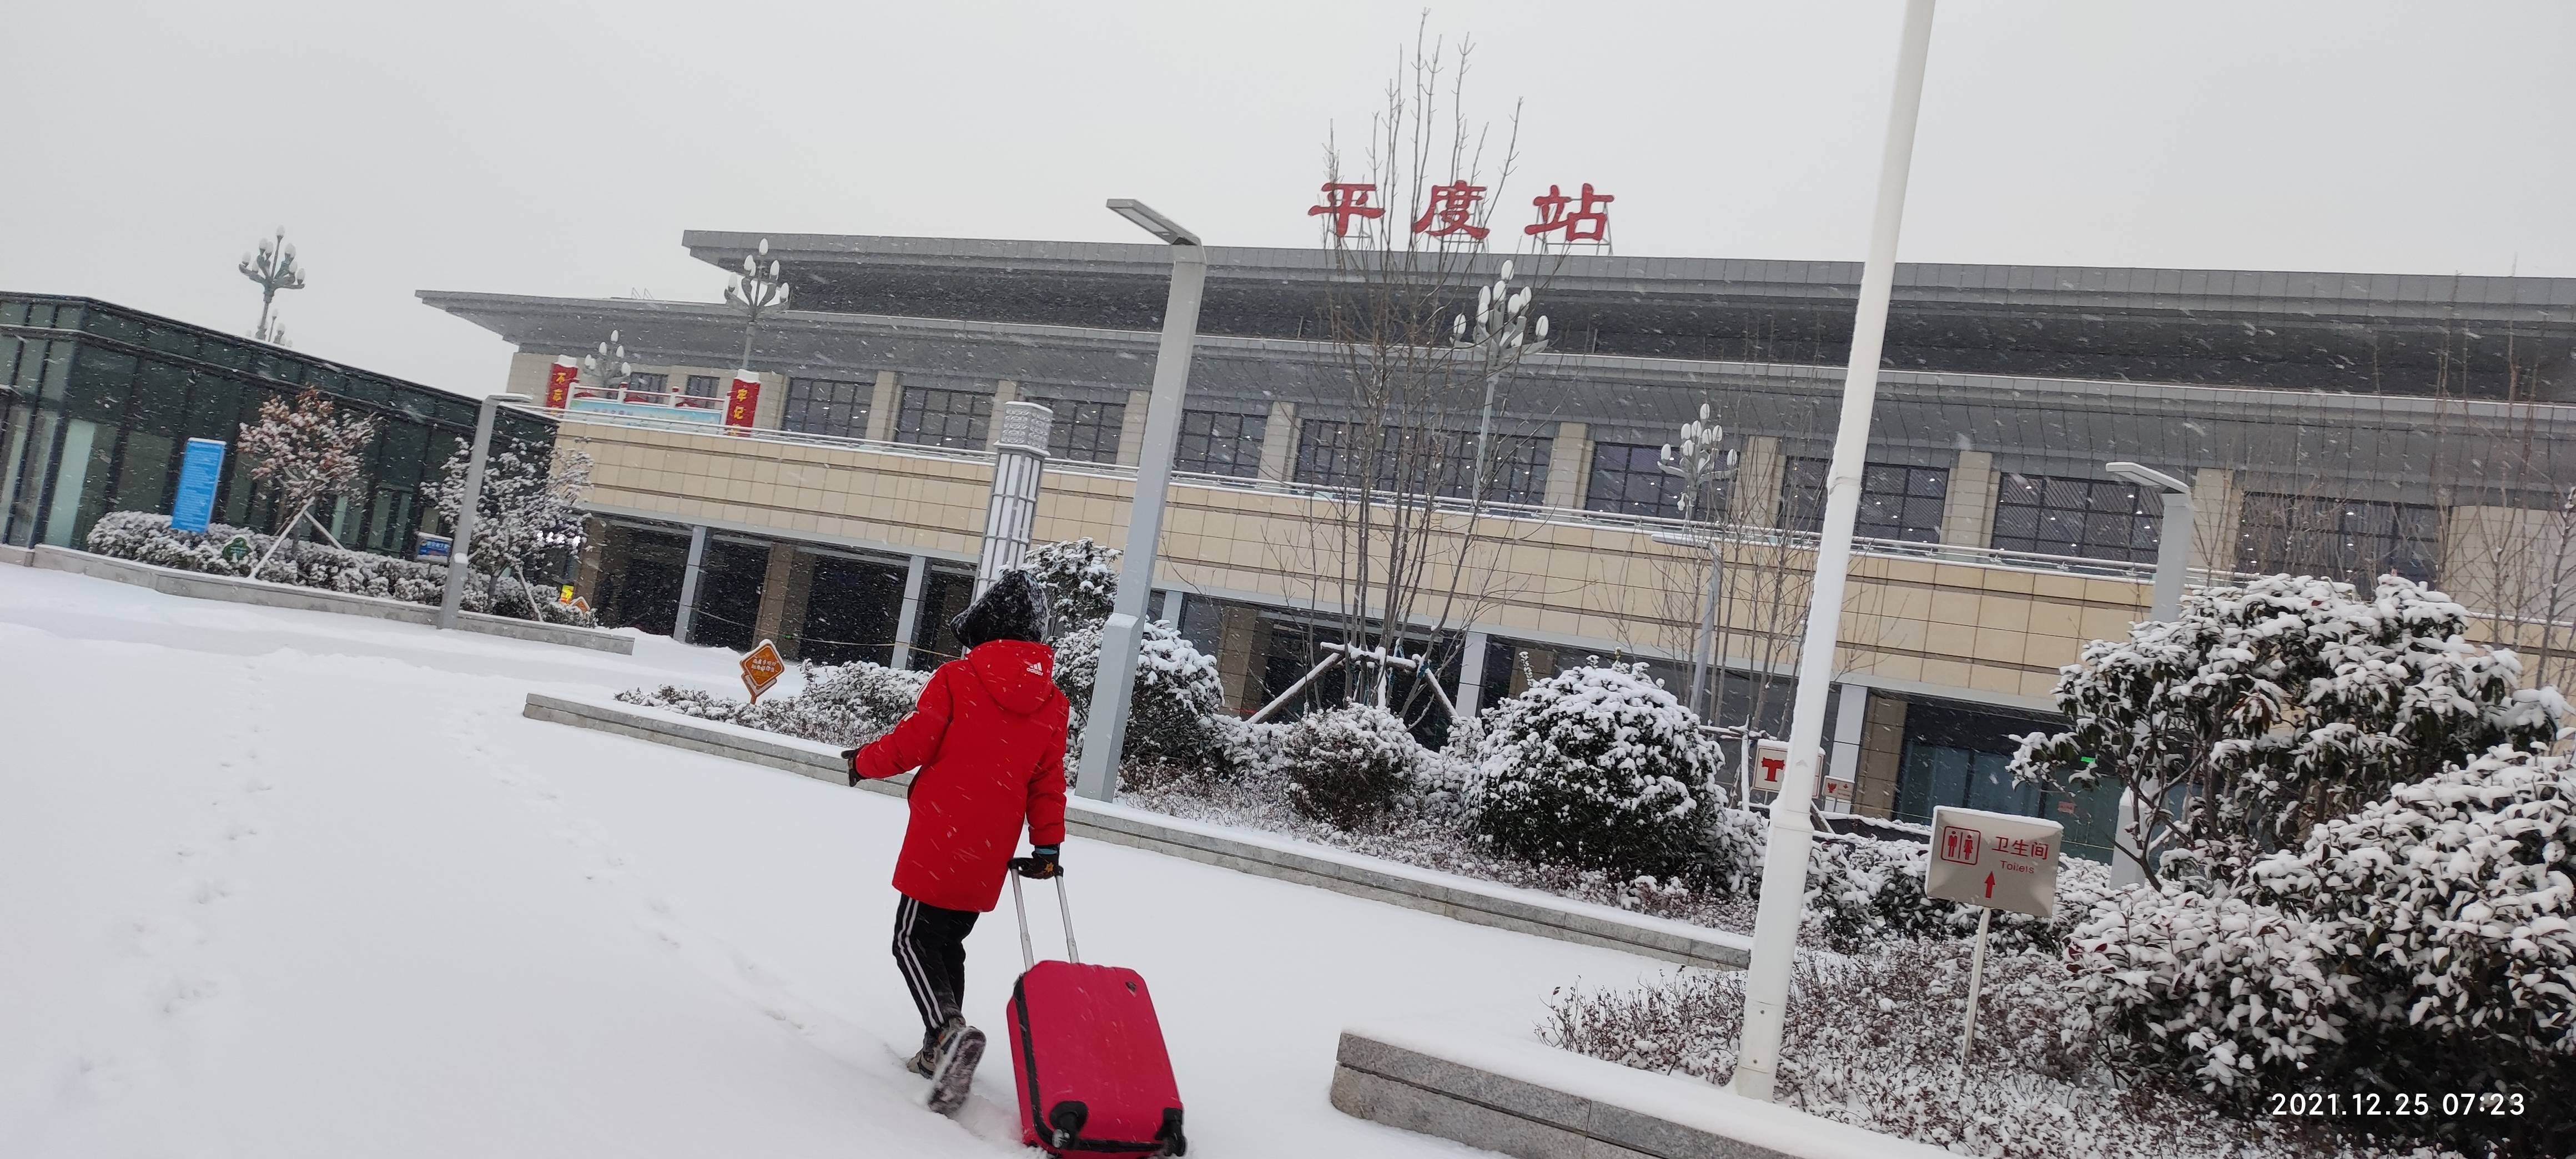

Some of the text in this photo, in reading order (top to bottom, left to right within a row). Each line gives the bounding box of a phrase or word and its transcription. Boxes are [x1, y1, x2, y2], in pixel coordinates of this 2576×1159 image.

[1308, 180, 1614, 242] 平度站
[1991, 835, 2049, 860] 卫生间
[2000, 860, 2035, 874] Toilets
